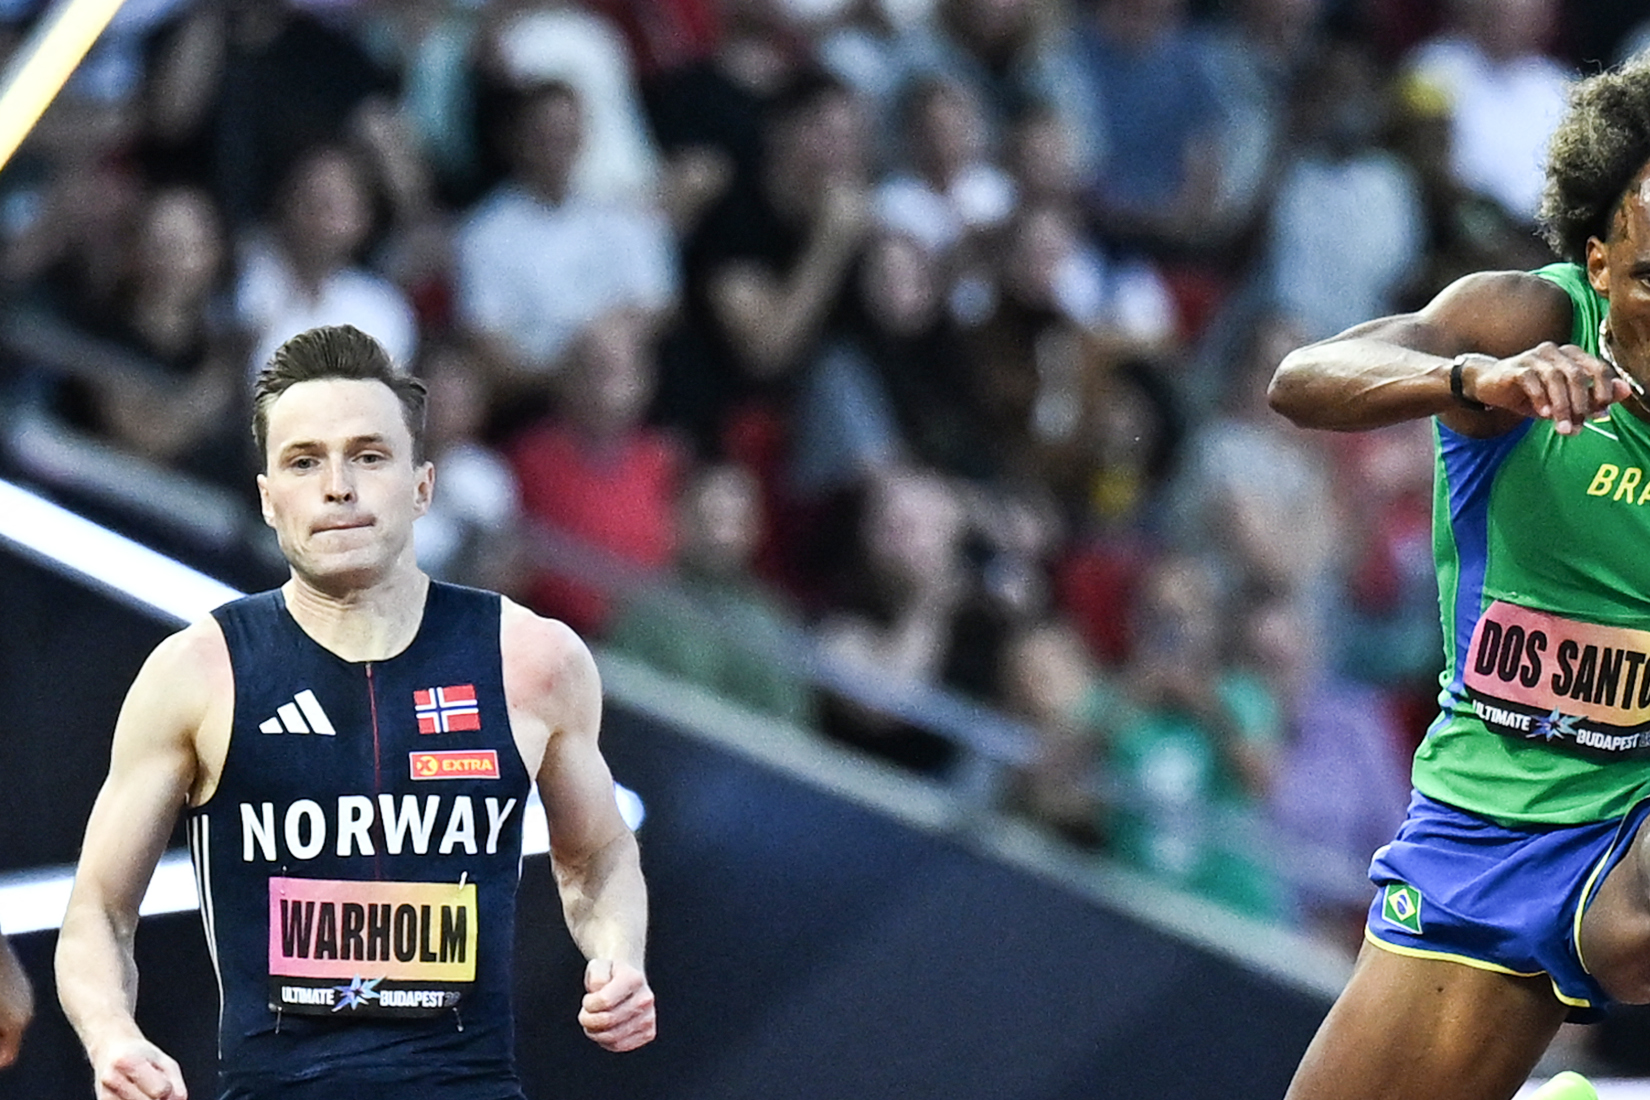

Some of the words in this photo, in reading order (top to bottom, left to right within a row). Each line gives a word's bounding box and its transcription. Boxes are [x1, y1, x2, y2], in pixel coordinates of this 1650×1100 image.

[1474, 618, 1548, 688] DOS
[1472, 699, 1532, 731] ULTIMATE
[442, 758, 493, 771] EXTRA
[240, 794, 517, 862] NORWAY
[279, 899, 467, 964] WARHOLM
[281, 986, 335, 1006] ULTIMATE
